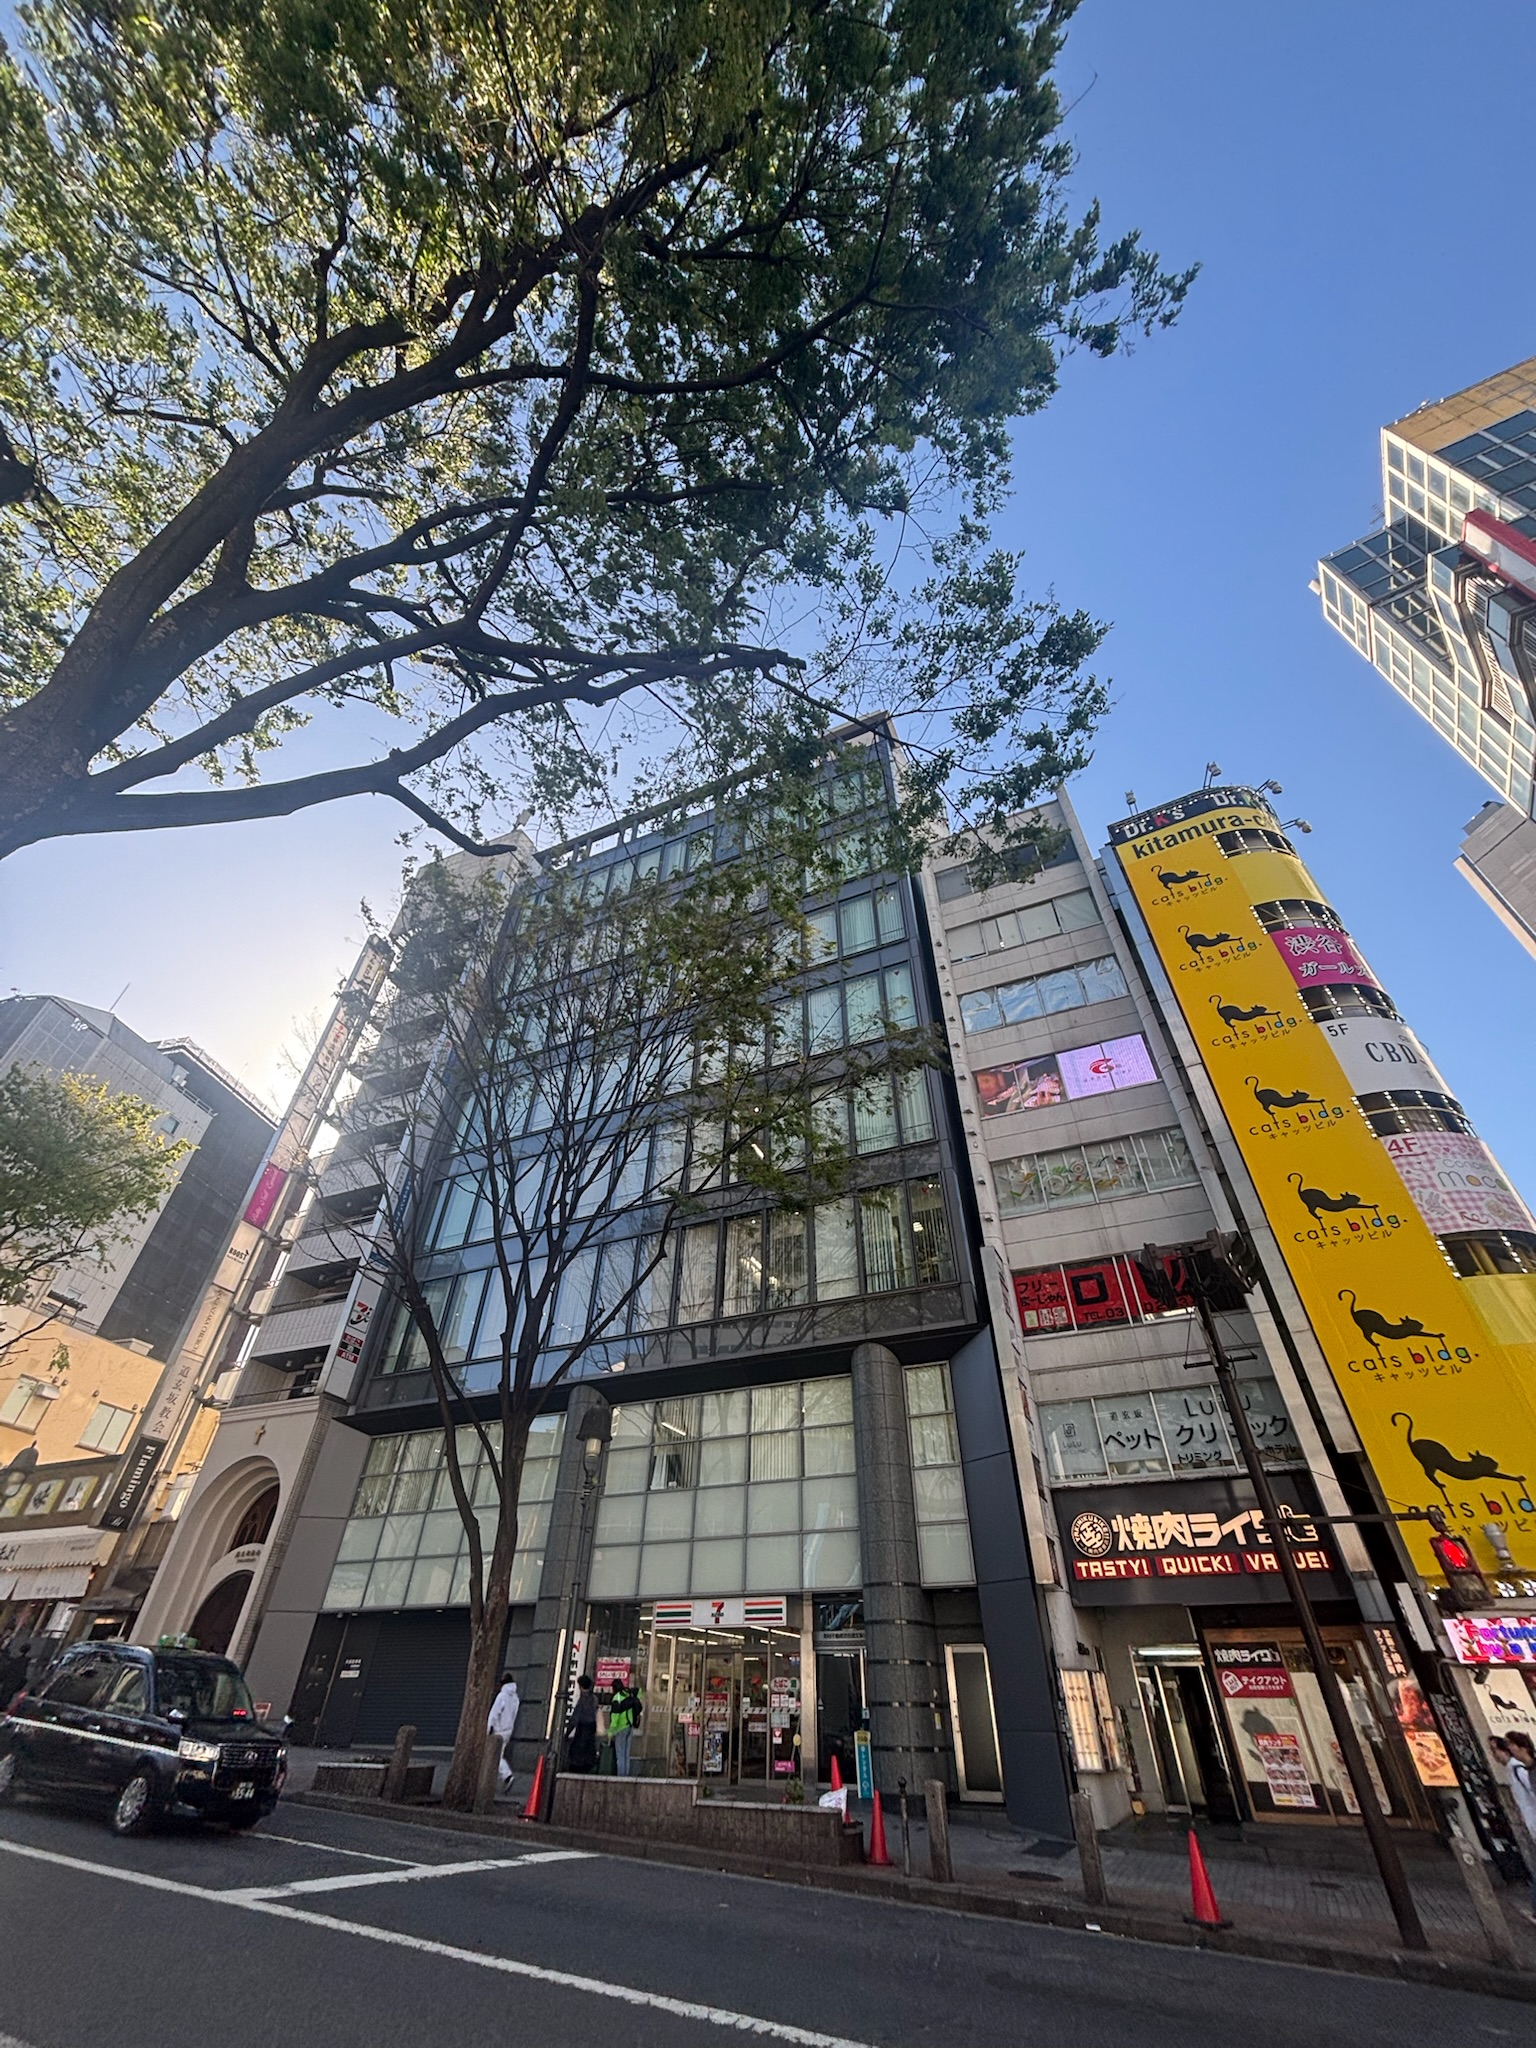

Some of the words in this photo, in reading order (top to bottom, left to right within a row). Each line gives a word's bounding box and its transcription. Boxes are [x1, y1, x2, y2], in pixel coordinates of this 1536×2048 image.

[1151, 889, 1185, 906] cats
[1285, 934, 1344, 957] 渋谷
[1179, 952, 1214, 972] cats
[1195, 951, 1252, 973] キャッツビル
[1211, 1026, 1251, 1048] cats
[1228, 1028, 1291, 1050] キャッツビル
[1326, 1022, 1350, 1038] 5F
[1249, 1115, 1292, 1137] cats
[1268, 1119, 1338, 1141] キャッツビル
[1384, 1136, 1419, 1155] 4F
[1294, 1219, 1342, 1244] cats
[1315, 1229, 1393, 1251] キャッツビル
[1016, 1279, 1058, 1296] フリー
[1347, 1347, 1402, 1373] cats
[1373, 1363, 1463, 1383] キャッツビル
[151, 1364, 192, 1434] 道玄坂教会
[1104, 1427, 1161, 1450] ペット
[1177, 1449, 1223, 1465] トリミング
[118, 1444, 157, 1509] Flamingo
[1076, 1557, 1149, 1578] TASTY!
[1161, 1554, 1234, 1575] QUICK!
[1245, 1551, 1330, 1572] VAUE!
[1241, 1675, 1288, 1686] テイクアウト
